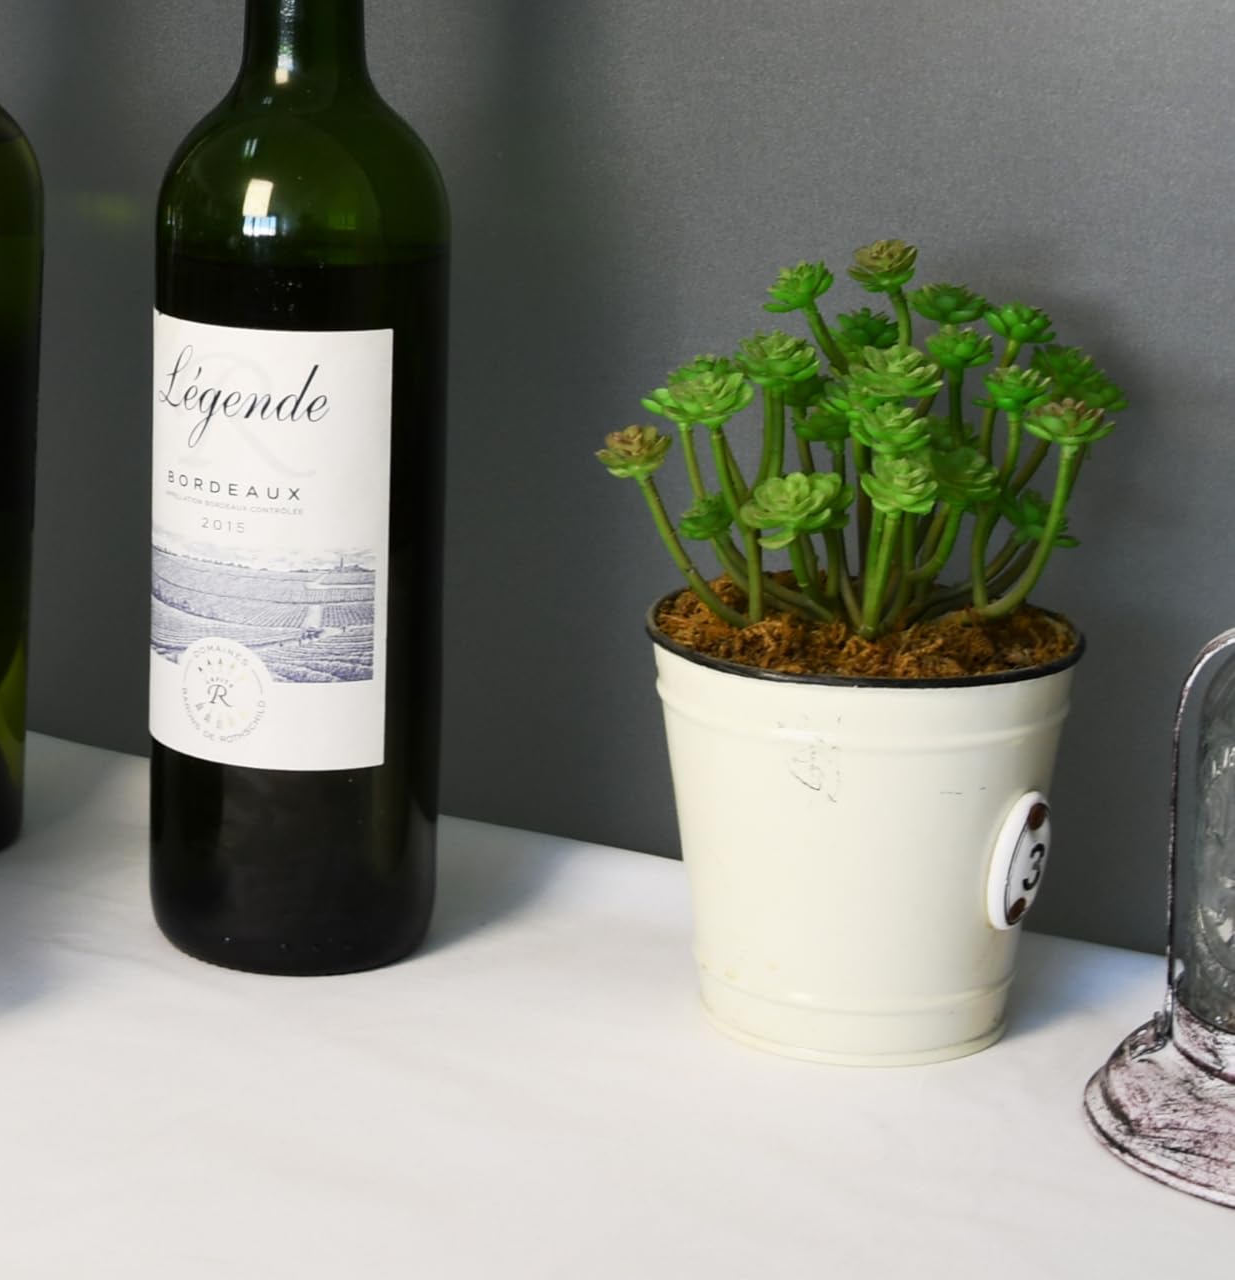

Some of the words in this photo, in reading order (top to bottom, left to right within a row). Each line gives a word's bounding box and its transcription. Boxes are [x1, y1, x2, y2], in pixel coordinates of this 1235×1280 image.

[158, 344, 330, 449] Légende
[167, 470, 301, 501] BORDEAUX
[201, 517, 245, 534] 2015
[207, 684, 234, 707] R
[1022, 842, 1046, 892] 3
